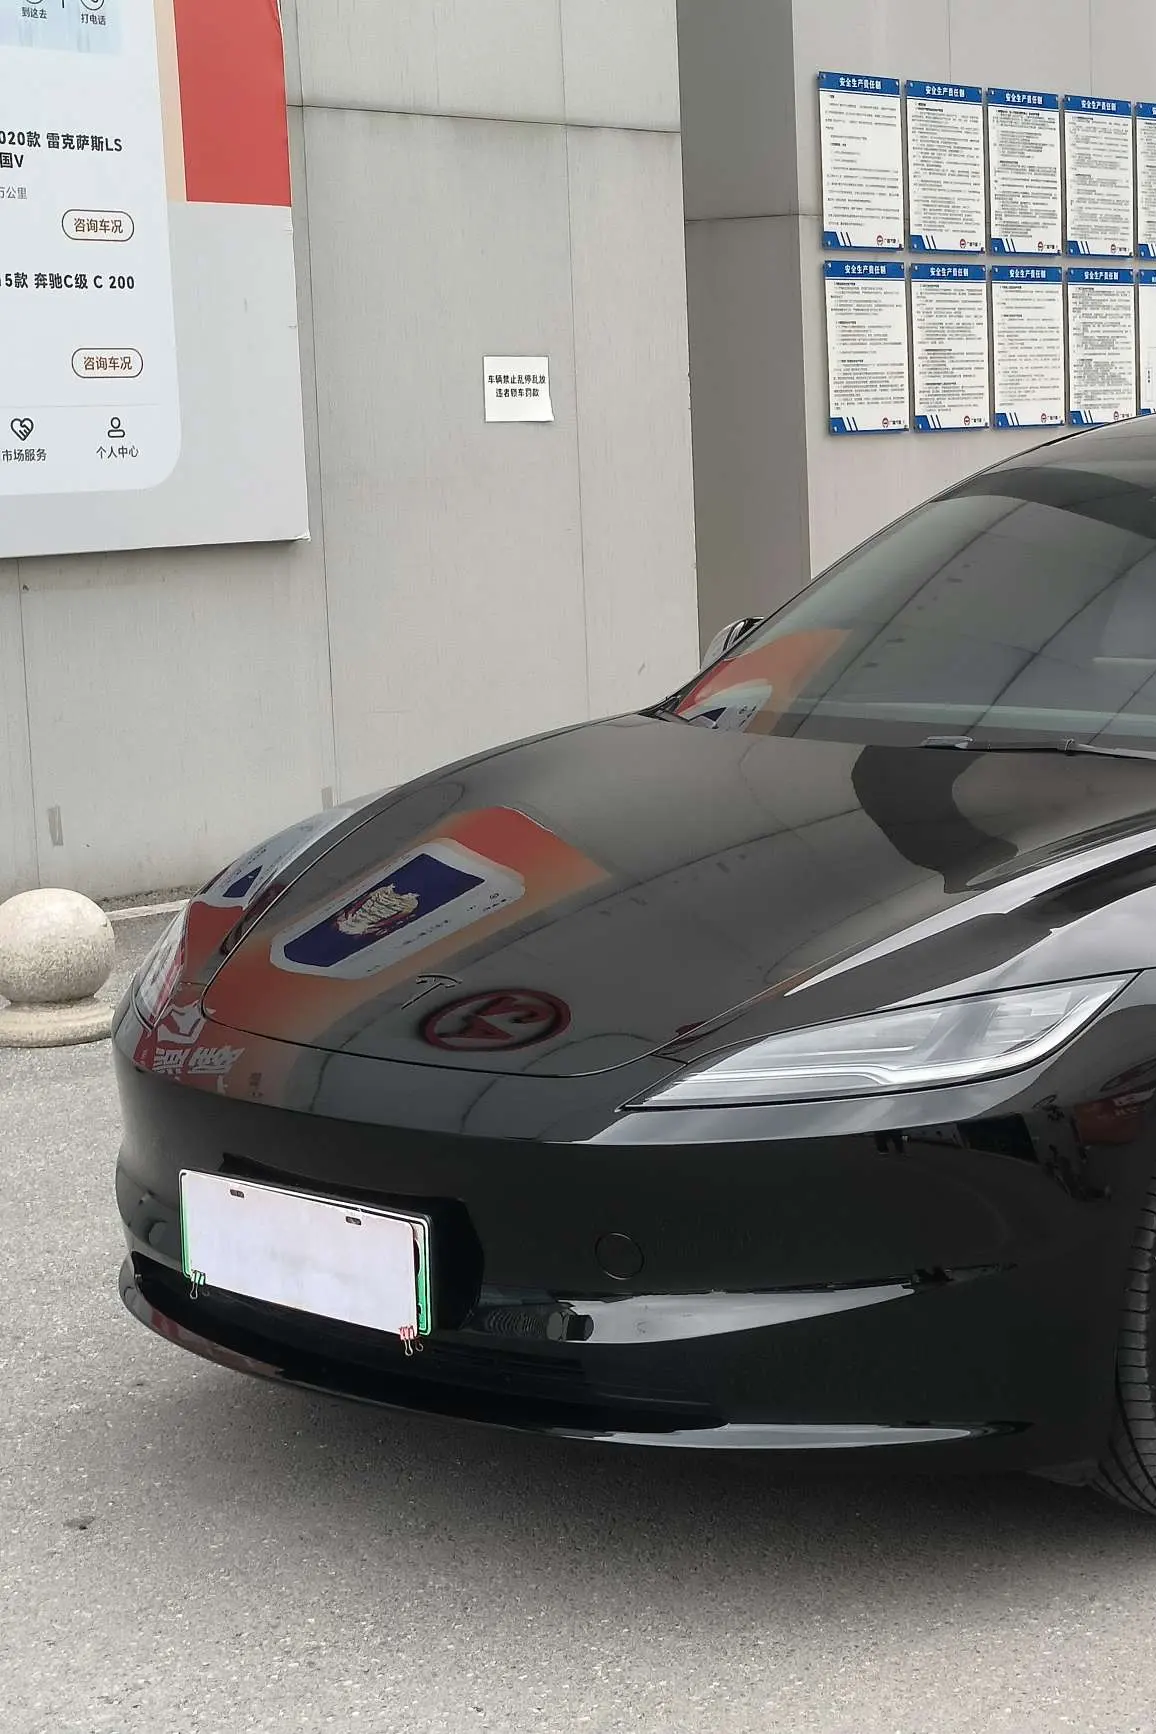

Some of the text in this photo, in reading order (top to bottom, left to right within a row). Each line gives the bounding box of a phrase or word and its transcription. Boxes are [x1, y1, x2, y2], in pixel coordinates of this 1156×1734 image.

[22, 7, 47, 19] 到这去
[81, 13, 106, 26] 打电话
[839, 77, 882, 90] 安全生产责任制
[925, 86, 965, 98] 安全生产责任制
[1005, 94, 1043, 105] 安全生产责任制
[1081, 100, 1117, 111] 安全生产责任制
[47, 132, 123, 152] 雷克萨斯LS
[0, 152, 24, 168] 国V
[74, 218, 124, 233] 咨询车况
[844, 264, 886, 275] 安全生产责任制
[929, 267, 969, 277] 安全生产责任制
[1009, 269, 1047, 279] 安全生产责任制
[1083, 271, 1119, 281] 安全生产责任制
[34, 272, 88, 289] 奔驰C级
[93, 275, 104, 289] C
[109, 275, 135, 290] 200
[83, 356, 133, 371] 咨询车况
[2, 448, 47, 462] 市场服务
[96, 445, 139, 459] 个人中心
